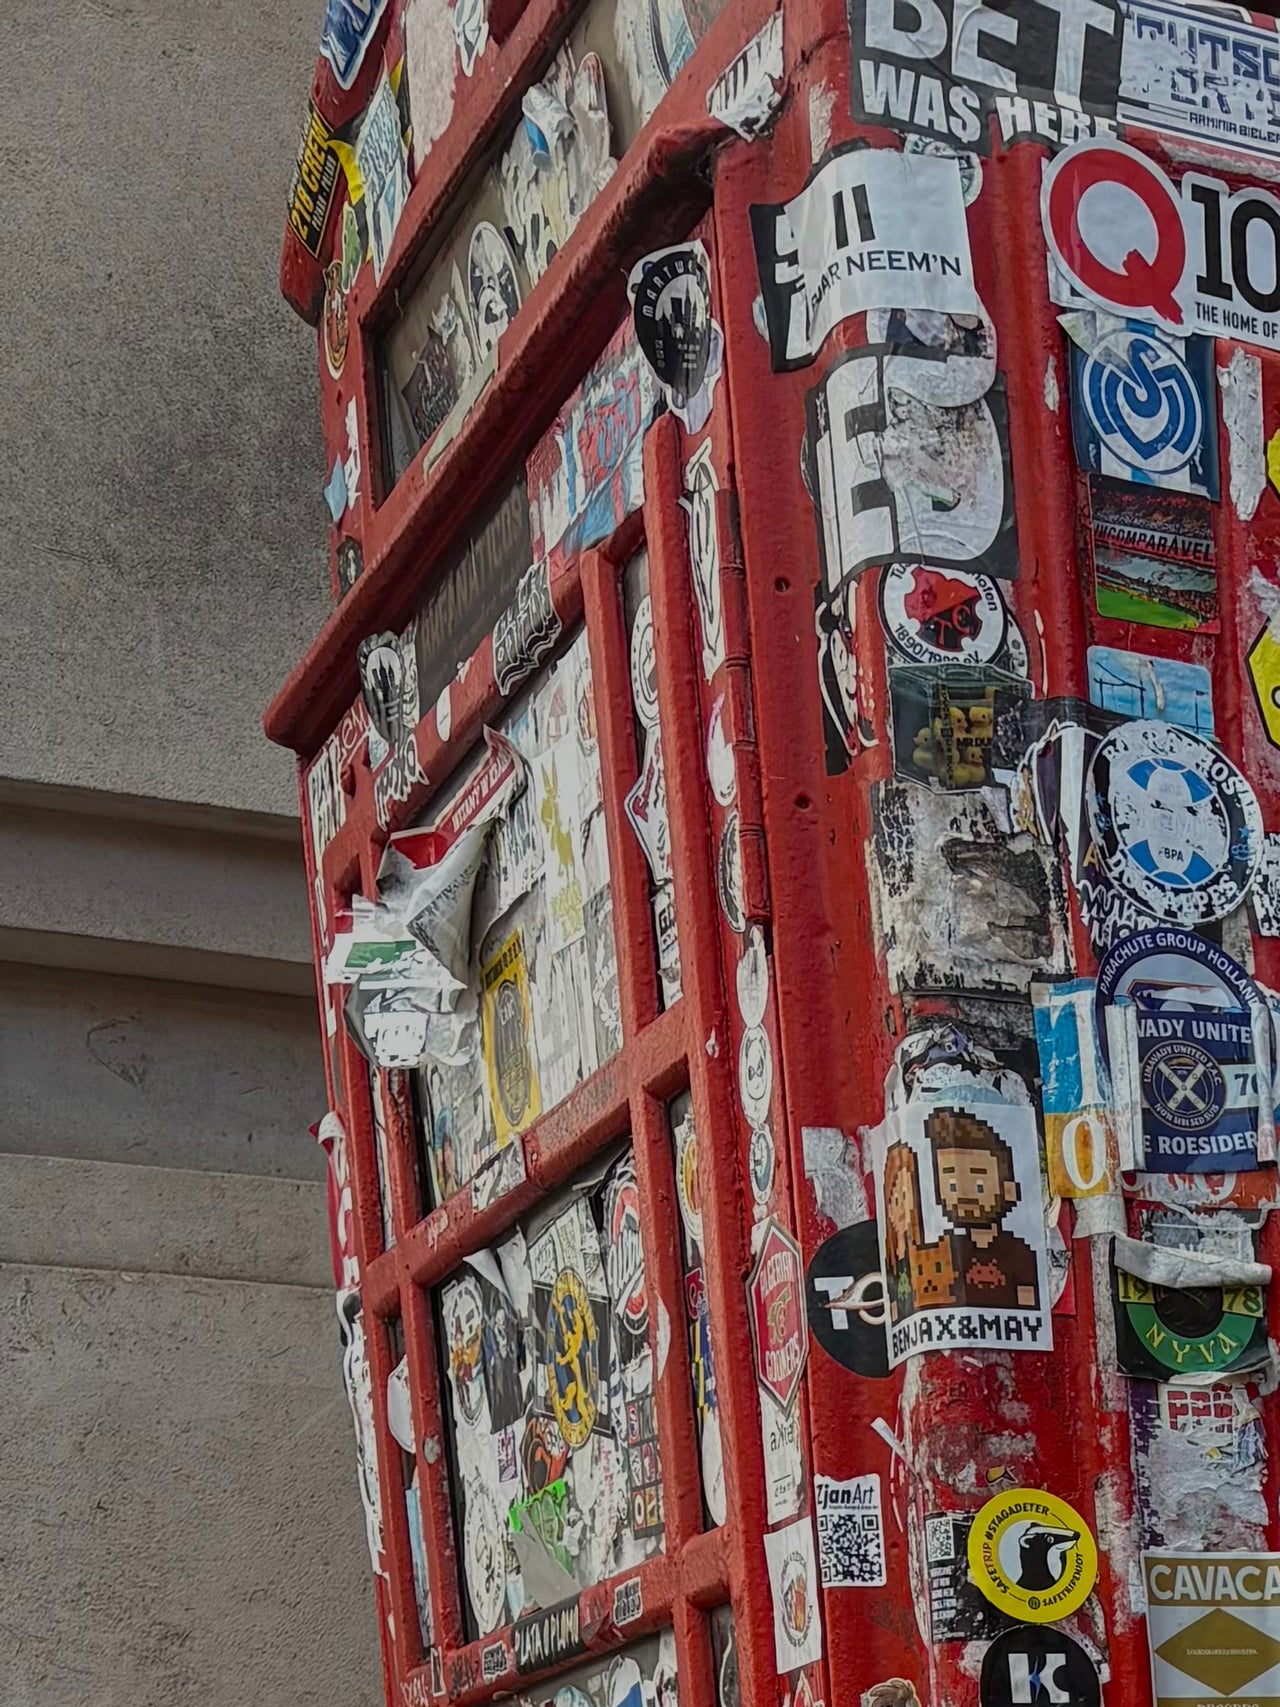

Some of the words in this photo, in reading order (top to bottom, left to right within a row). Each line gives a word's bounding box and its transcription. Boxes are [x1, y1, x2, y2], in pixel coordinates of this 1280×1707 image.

[858, 60, 982, 143] WAS
[1050, 156, 1187, 325] Q
[1195, 301, 1220, 325] THE
[1223, 308, 1260, 336] HOME
[1263, 319, 1279, 340] OF
[1099, 933, 1154, 995] PARACHUTE
[1155, 932, 1208, 955] GROUP
